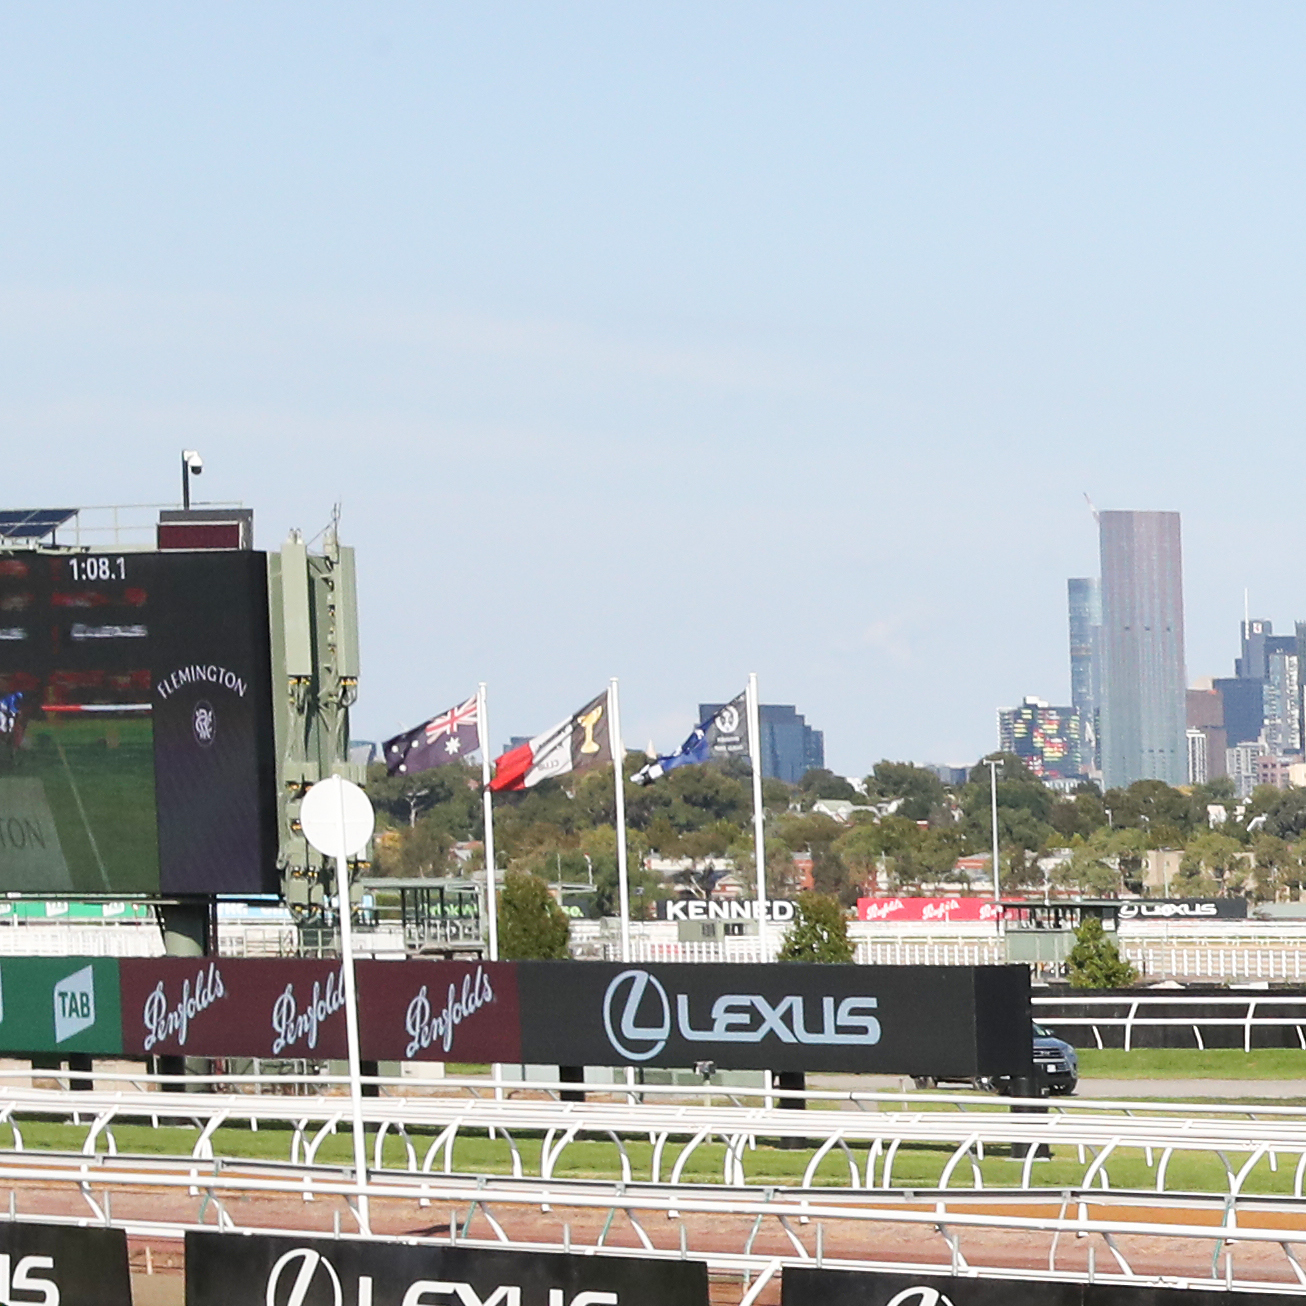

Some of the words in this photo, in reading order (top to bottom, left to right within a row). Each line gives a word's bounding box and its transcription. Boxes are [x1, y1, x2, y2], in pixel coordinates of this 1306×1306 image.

[69, 556, 126, 581] 1:08.1
[157, 665, 247, 699] FLEMINGTON
[58, 990, 91, 1020] TAB
[143, 962, 225, 1051] Penfolds
[271, 966, 347, 1055] Penfold
[405, 965, 493, 1059] Penfolds
[676, 993, 881, 1045] LEXUS
